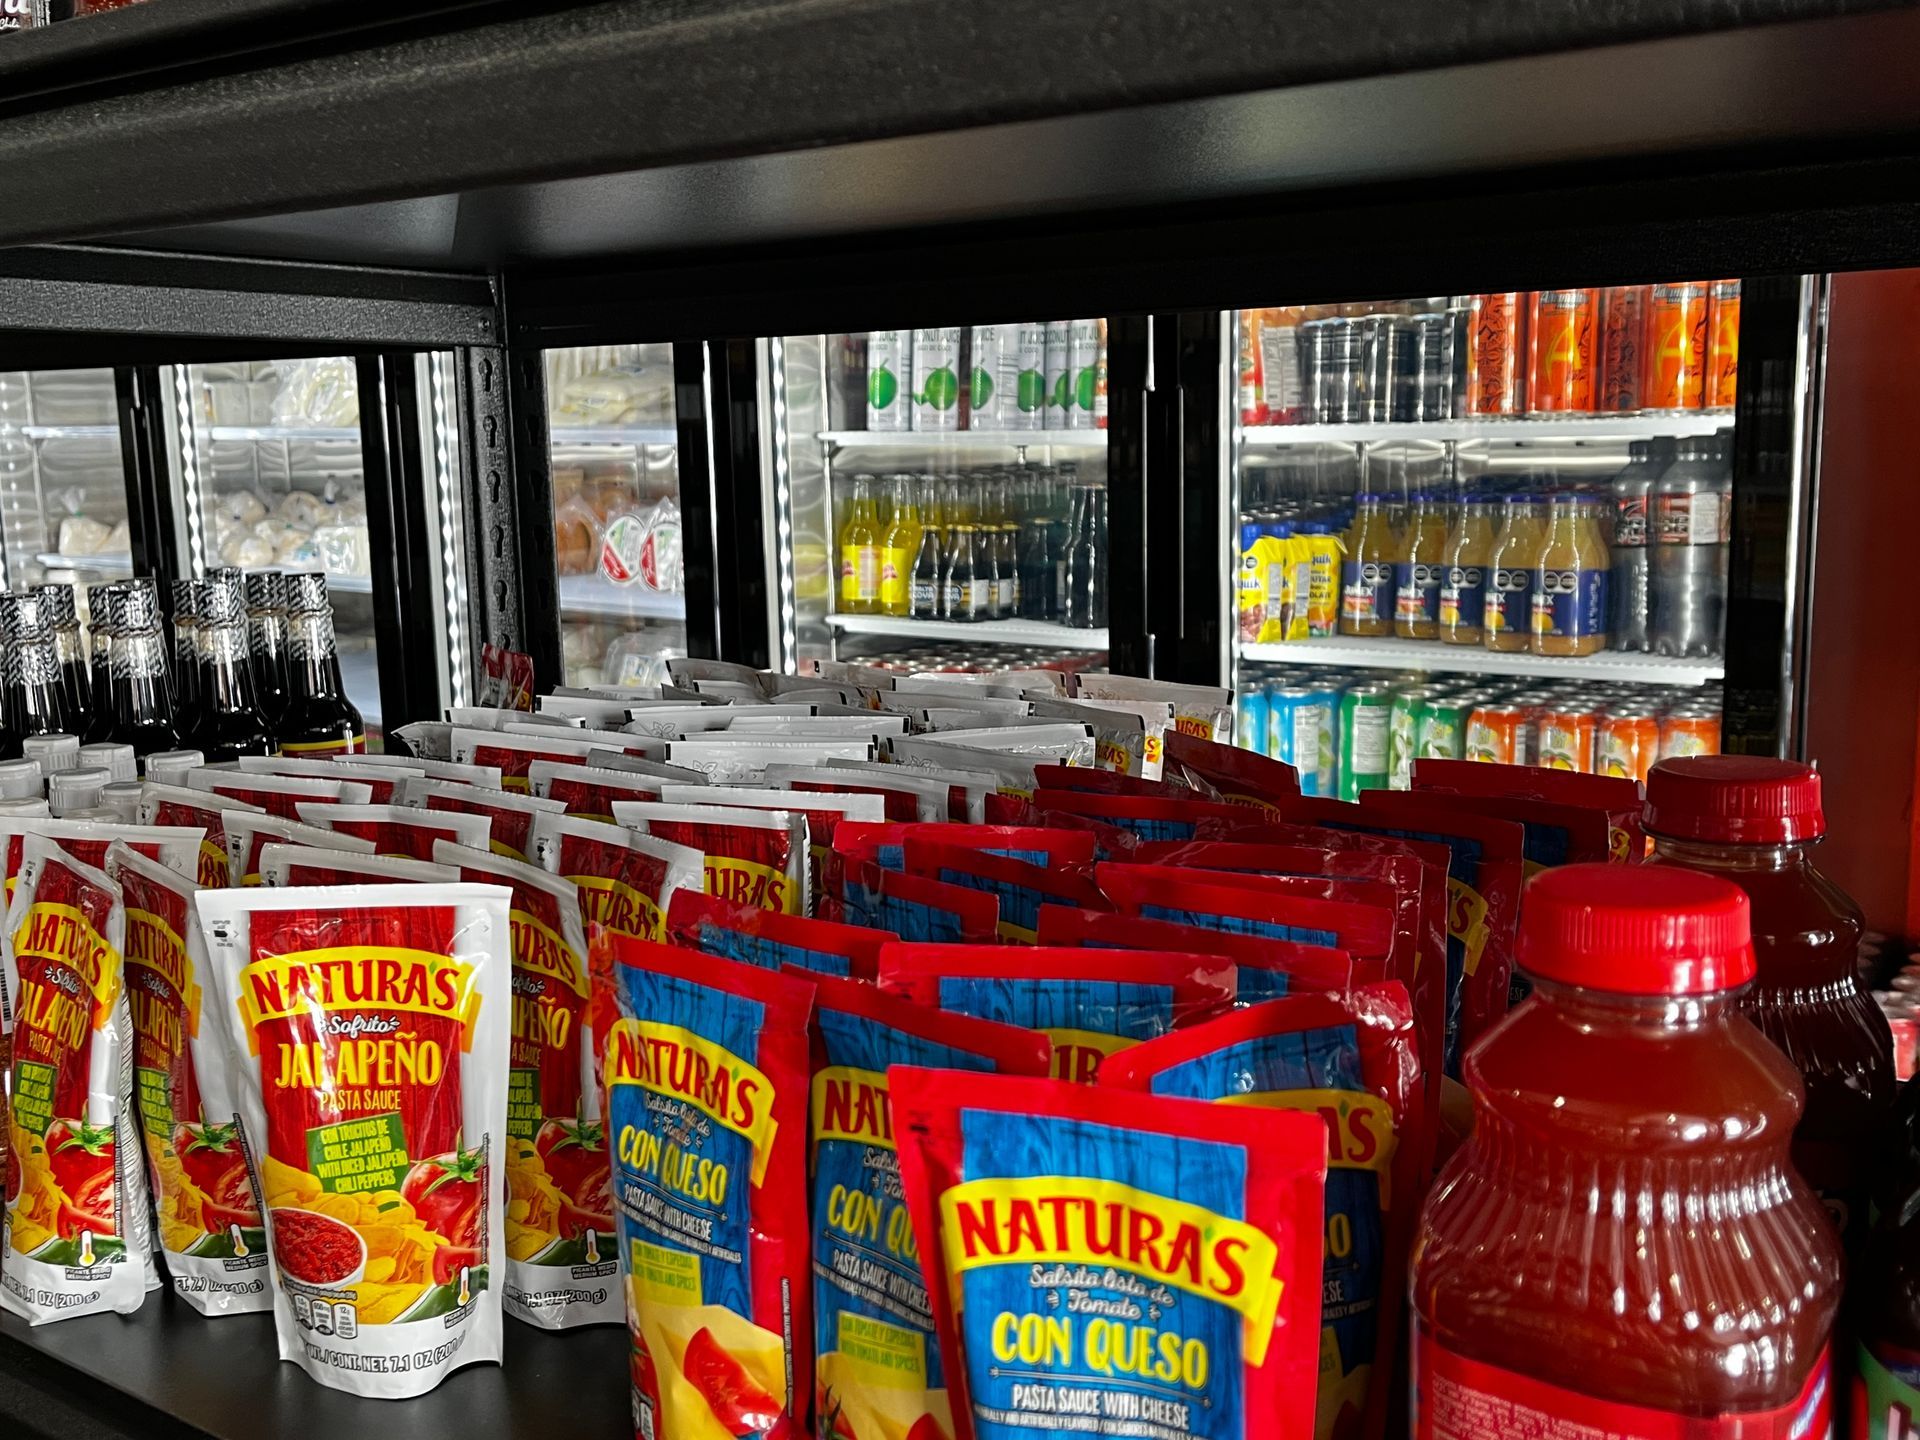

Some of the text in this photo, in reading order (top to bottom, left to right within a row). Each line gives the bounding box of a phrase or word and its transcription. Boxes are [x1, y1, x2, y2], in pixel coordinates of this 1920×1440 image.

[249, 959, 461, 1015] NATURA'S
[511, 977, 538, 994] ofrito
[329, 1014, 392, 1040] Sofrito
[319, 1089, 402, 1115] PASTA SAUCE
[616, 1030, 760, 1129] NATURA'S
[356, 1169, 396, 1191] PEPPERS
[618, 1124, 729, 1206] CON QUESO
[624, 1182, 647, 1207] PASTA
[663, 1203, 683, 1228] WITH
[682, 1211, 713, 1242] CHEESE
[828, 1183, 882, 1242] CON
[955, 1196, 1251, 1298] NATURA'S
[37, 1290, 55, 1307] OZ
[834, 1249, 861, 1279] PASTA
[860, 1259, 890, 1292] SAUCE
[888, 1272, 911, 1301] WITH
[1029, 1263, 1176, 1308] Salsita lista de
[1067, 1288, 1143, 1320] Tomate
[361, 1356, 389, 1374] NET.
[390, 1354, 411, 1373] 7.1
[412, 1349, 433, 1370] OZ
[992, 1311, 1210, 1390] CON QUESO
[1012, 1383, 1190, 1431] PASTA SAUCE WITH CHEESE
